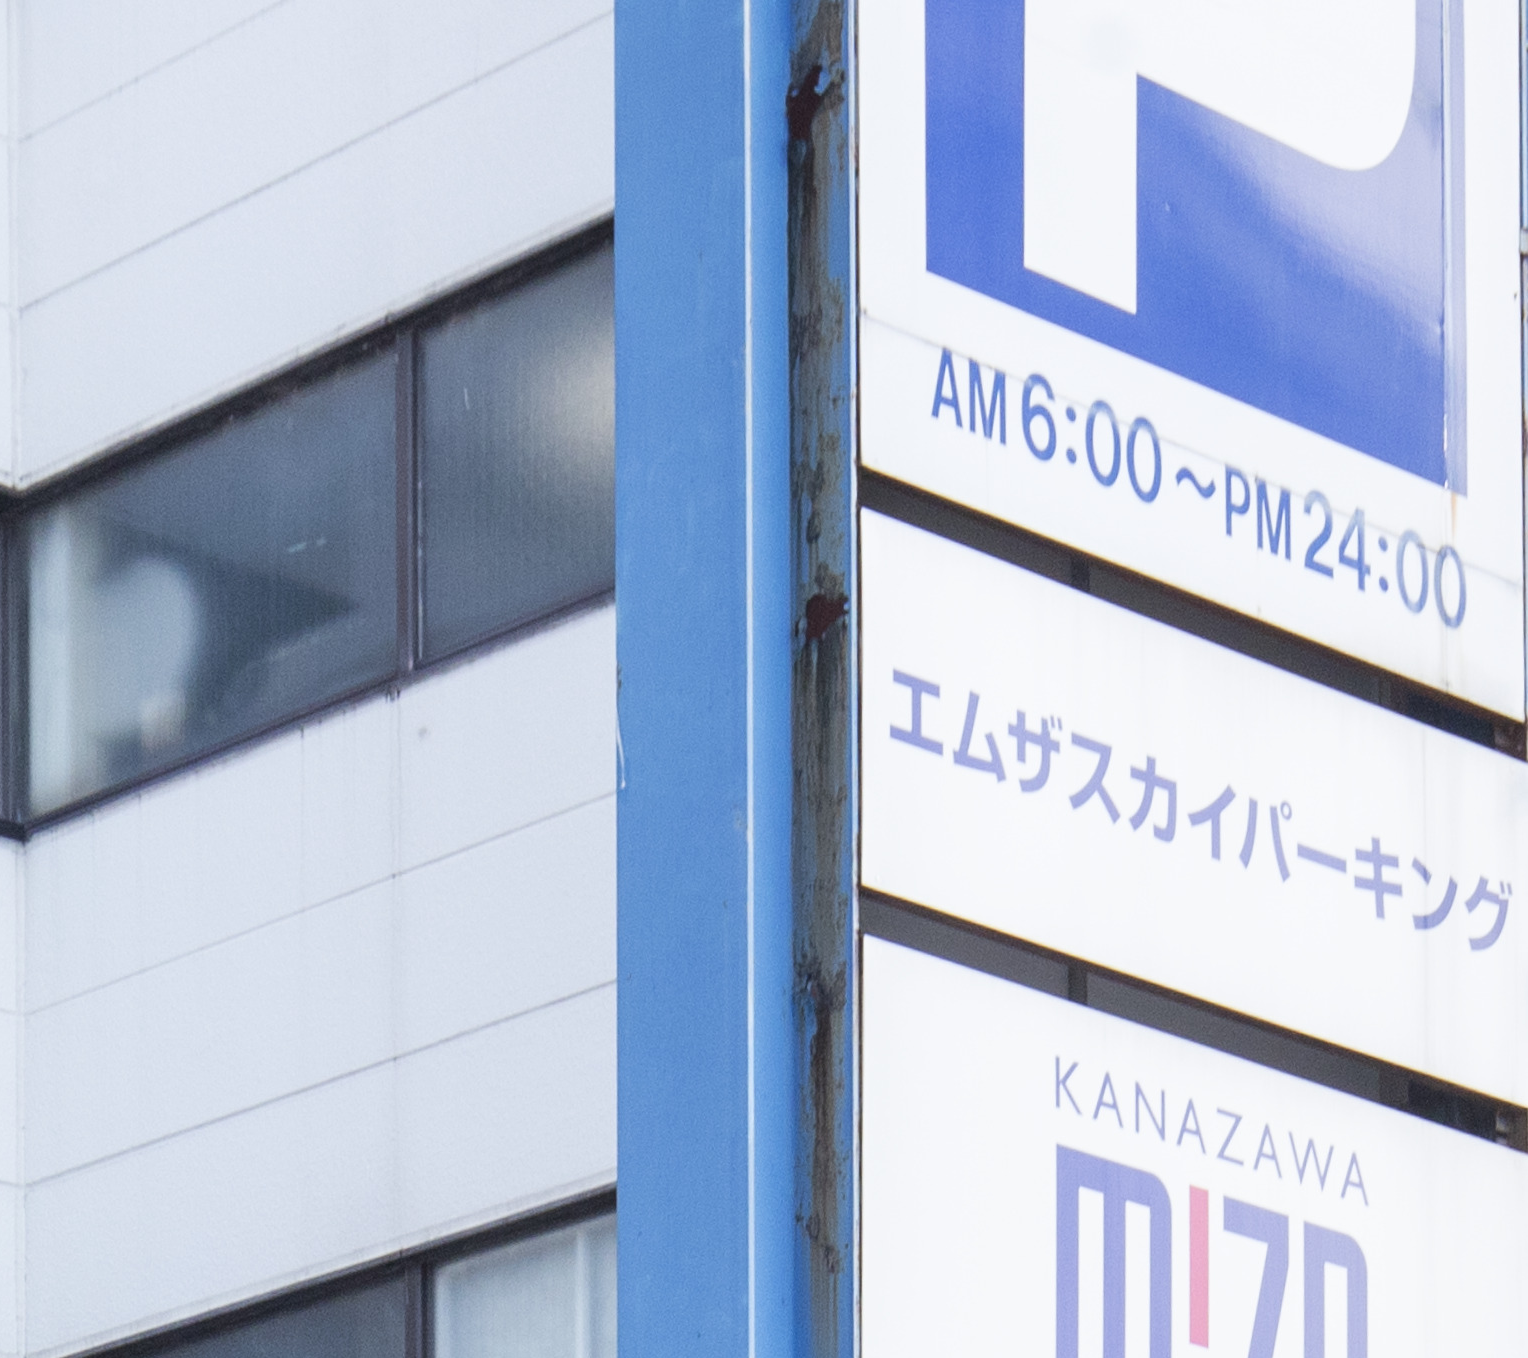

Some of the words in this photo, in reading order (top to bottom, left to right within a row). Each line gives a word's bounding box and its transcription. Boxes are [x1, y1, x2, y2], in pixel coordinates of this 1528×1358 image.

[889, 668, 1513, 951] エムザスカイパーキング
[1054, 1055, 1369, 1206] KANAZAWA
